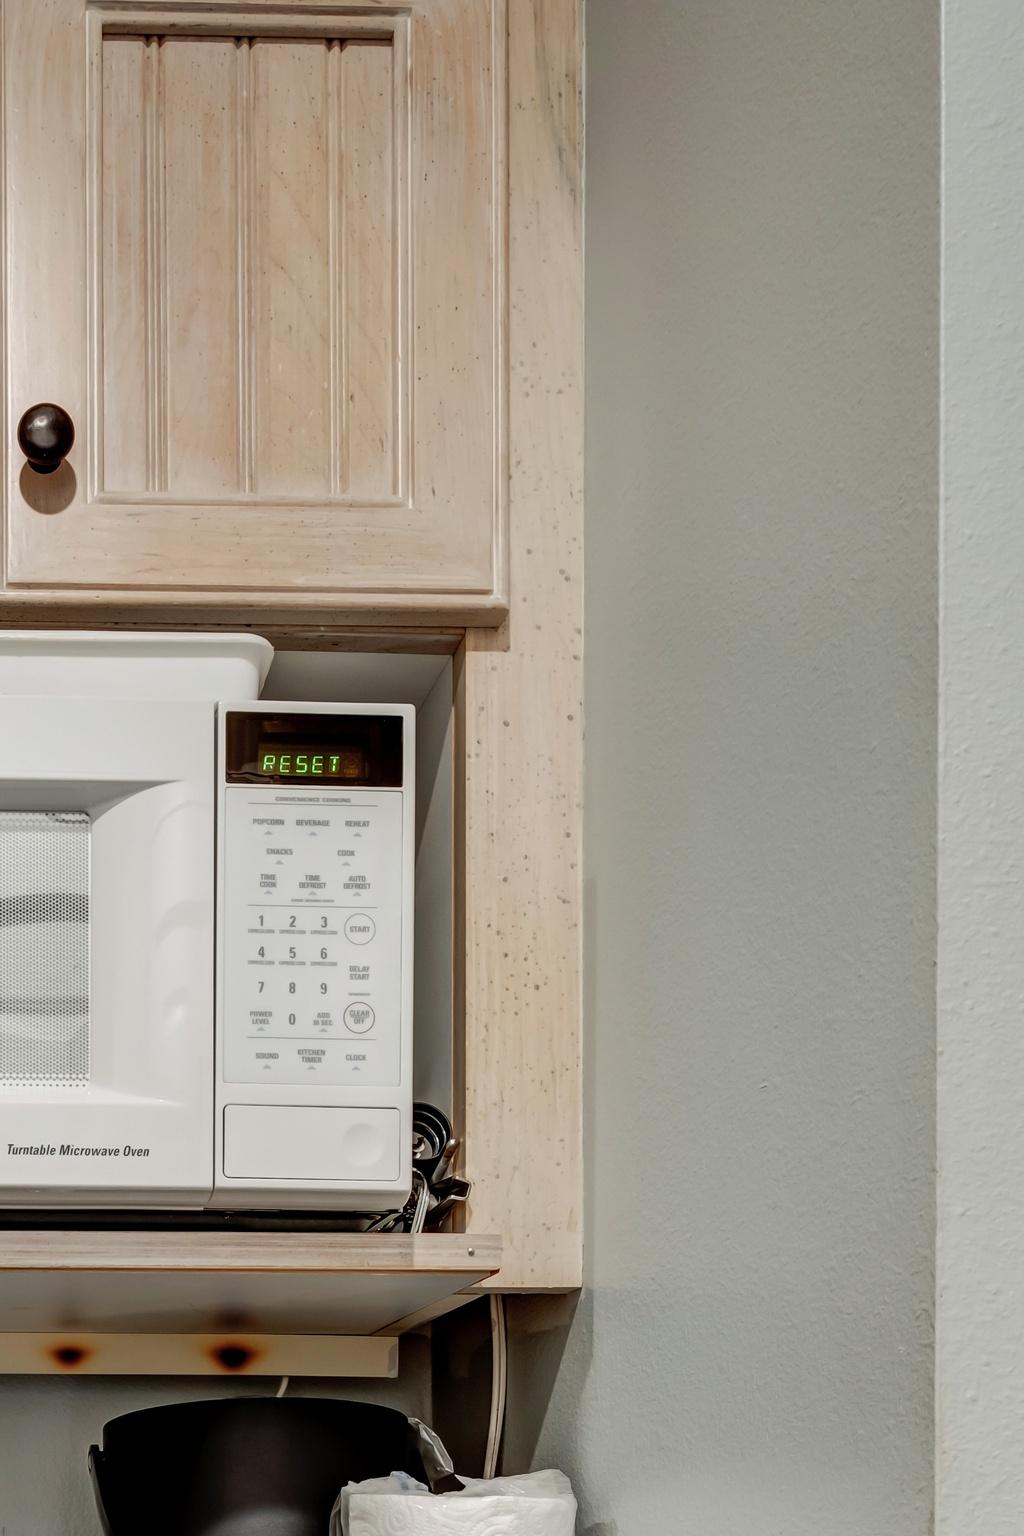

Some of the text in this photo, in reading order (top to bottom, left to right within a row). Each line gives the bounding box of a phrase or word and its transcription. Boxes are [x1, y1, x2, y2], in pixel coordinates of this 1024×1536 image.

[262, 755, 340, 773] RESET
[252, 818, 285, 826] POPCORN
[295, 819, 331, 827] BEVERAGE
[344, 820, 371, 828] REHEAT
[266, 848, 294, 856] SNACKS
[260, 873, 276, 881] TIME
[343, 882, 371, 890] DEFROST
[258, 914, 264, 927] 1
[289, 915, 297, 928] 2
[320, 916, 328, 928] 3
[257, 946, 265, 958] 4
[289, 947, 297, 959] 5
[320, 947, 328, 960] 6
[349, 965, 370, 973] DELAY
[257, 981, 265, 994] 7
[288, 982, 296, 994] 8
[320, 982, 328, 995] 9
[288, 1013, 296, 1025] 0
[349, 1010, 371, 1018] CLEAR
[255, 1052, 279, 1060] SOUND
[301, 1056, 322, 1064] TIMER
[7, 1143, 150, 1157] Turntable Microwave Oven
